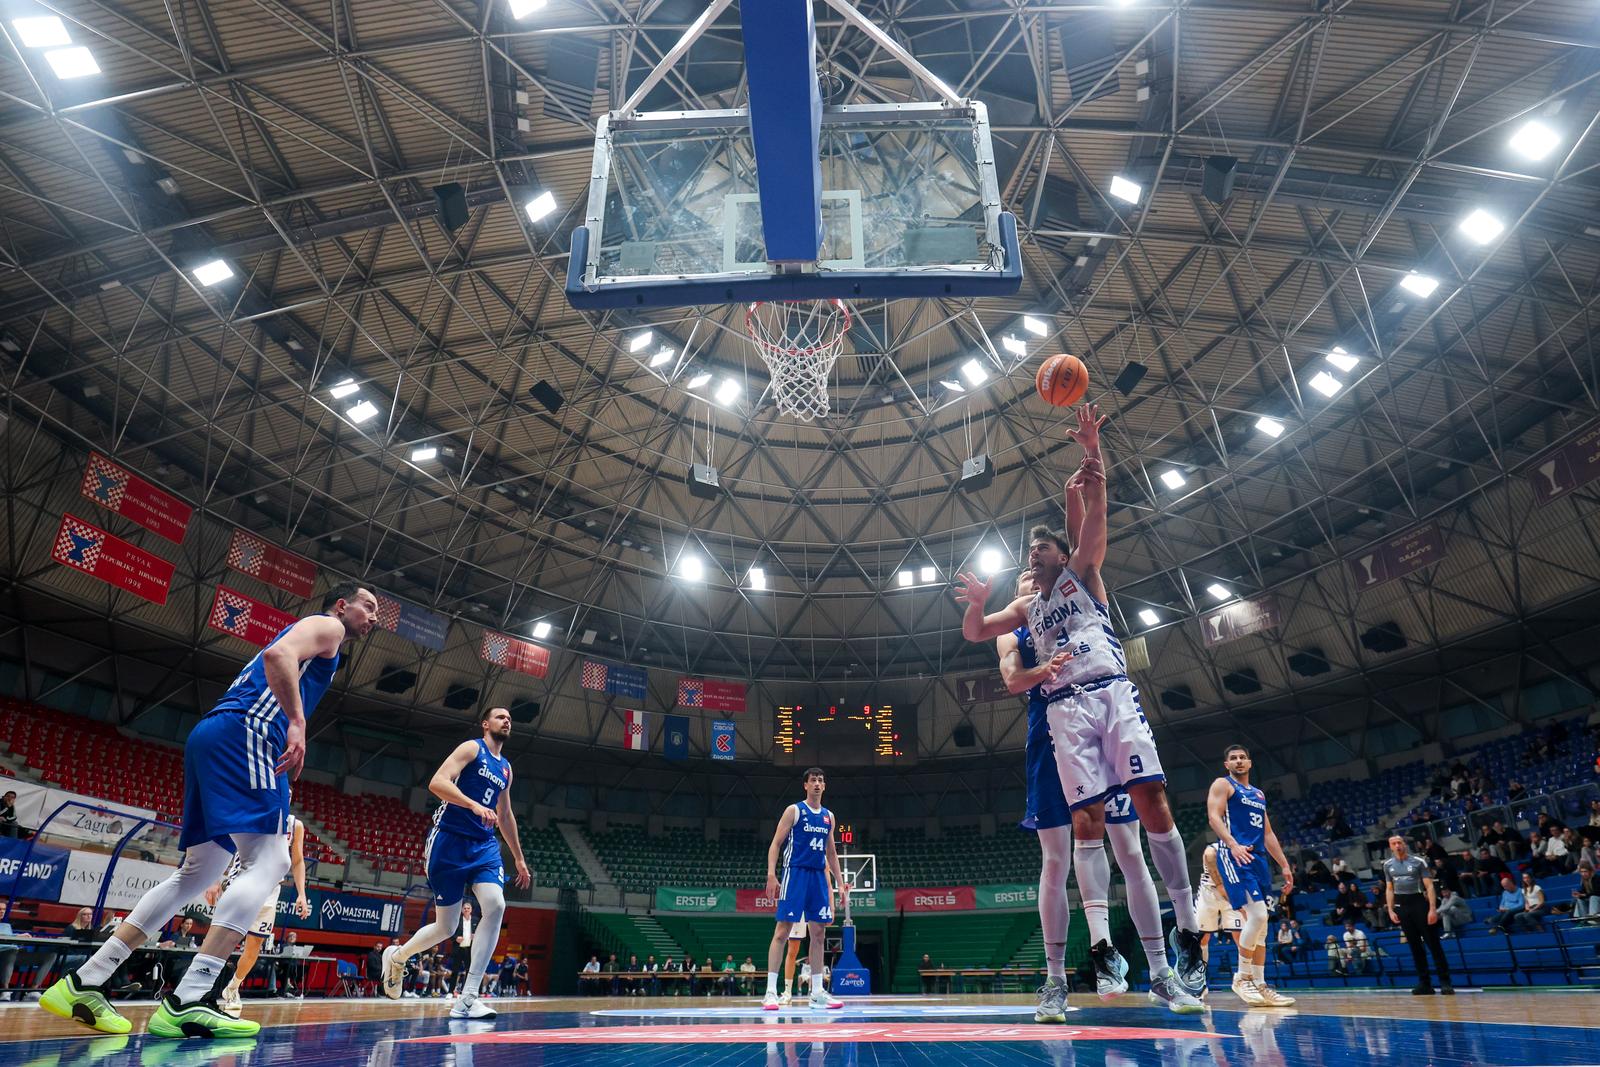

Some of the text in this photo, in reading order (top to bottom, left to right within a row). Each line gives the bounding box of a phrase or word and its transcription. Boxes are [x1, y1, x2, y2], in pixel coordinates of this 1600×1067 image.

[126, 551, 152, 569] PRVAK
[99, 552, 168, 588] REPUBLIKE HRVATSKE
[1035, 600, 1083, 638] CIBONA
[1129, 755, 1144, 775] 9
[477, 764, 507, 791] dinamo
[482, 787, 495, 806] 9
[1105, 793, 1132, 818] 47
[1249, 811, 1264, 829] 32
[803, 822, 829, 835] dinamo
[809, 836, 825, 851] 44
[841, 832, 853, 844] 10
[675, 896, 706, 906] ERSTE
[914, 896, 945, 906] ERSTE
[995, 892, 1026, 903] ERSTE
[342, 906, 380, 920] MAISTRAL
[259, 921, 273, 933] 24
